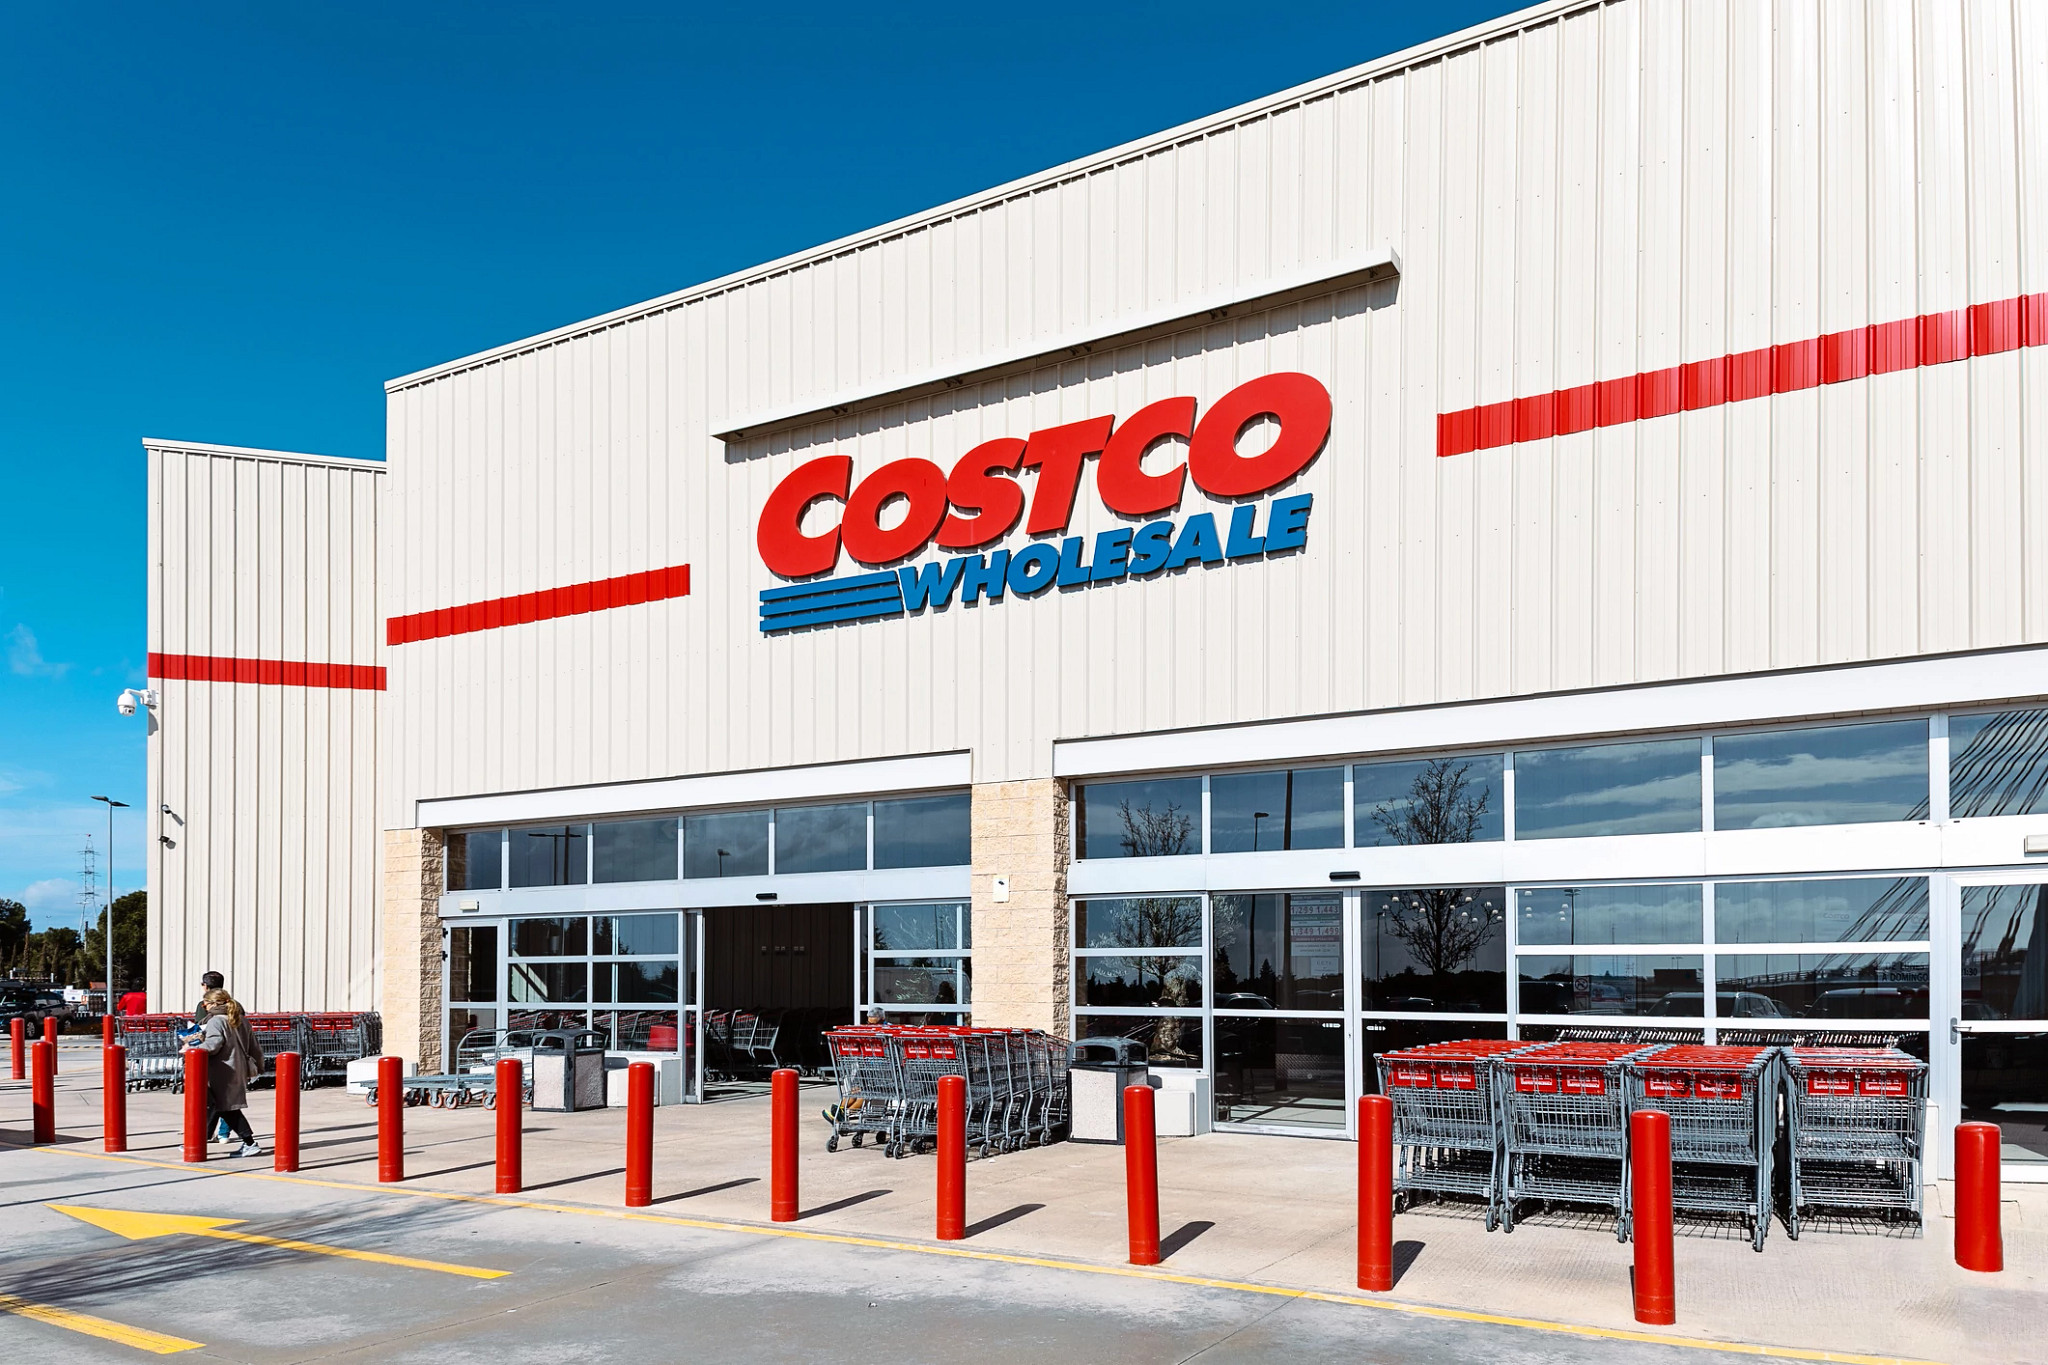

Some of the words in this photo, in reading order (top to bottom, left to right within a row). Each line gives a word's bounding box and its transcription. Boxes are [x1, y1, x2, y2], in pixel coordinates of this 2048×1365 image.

[757, 372, 1333, 577] COSTCO
[898, 493, 1313, 611] WHOLESALE
[1882, 973, 1887, 981] A
[1890, 973, 1929, 982] DOMINGO
